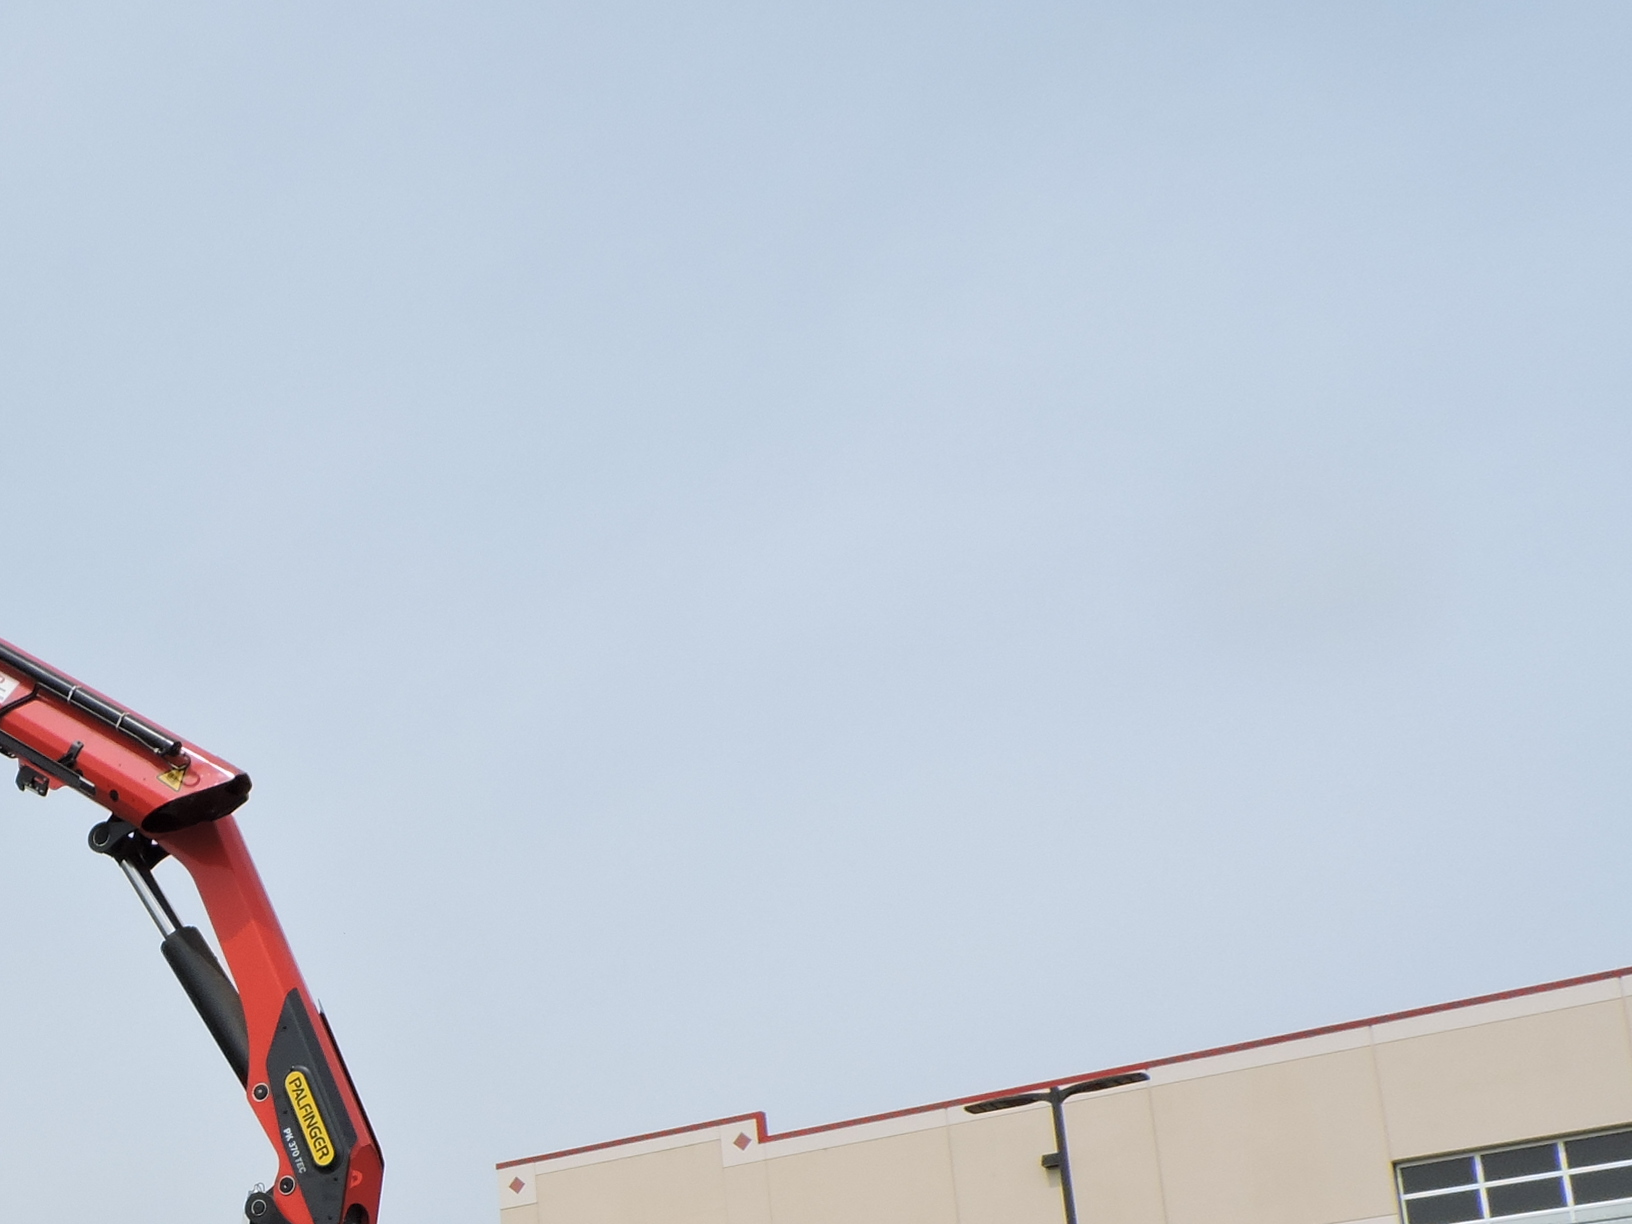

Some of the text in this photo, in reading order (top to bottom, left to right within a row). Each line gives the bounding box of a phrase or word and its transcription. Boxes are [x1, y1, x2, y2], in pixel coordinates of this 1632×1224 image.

[283, 1127, 307, 1174] PK 370 TEC
[289, 1076, 330, 1160] PALFINGER
